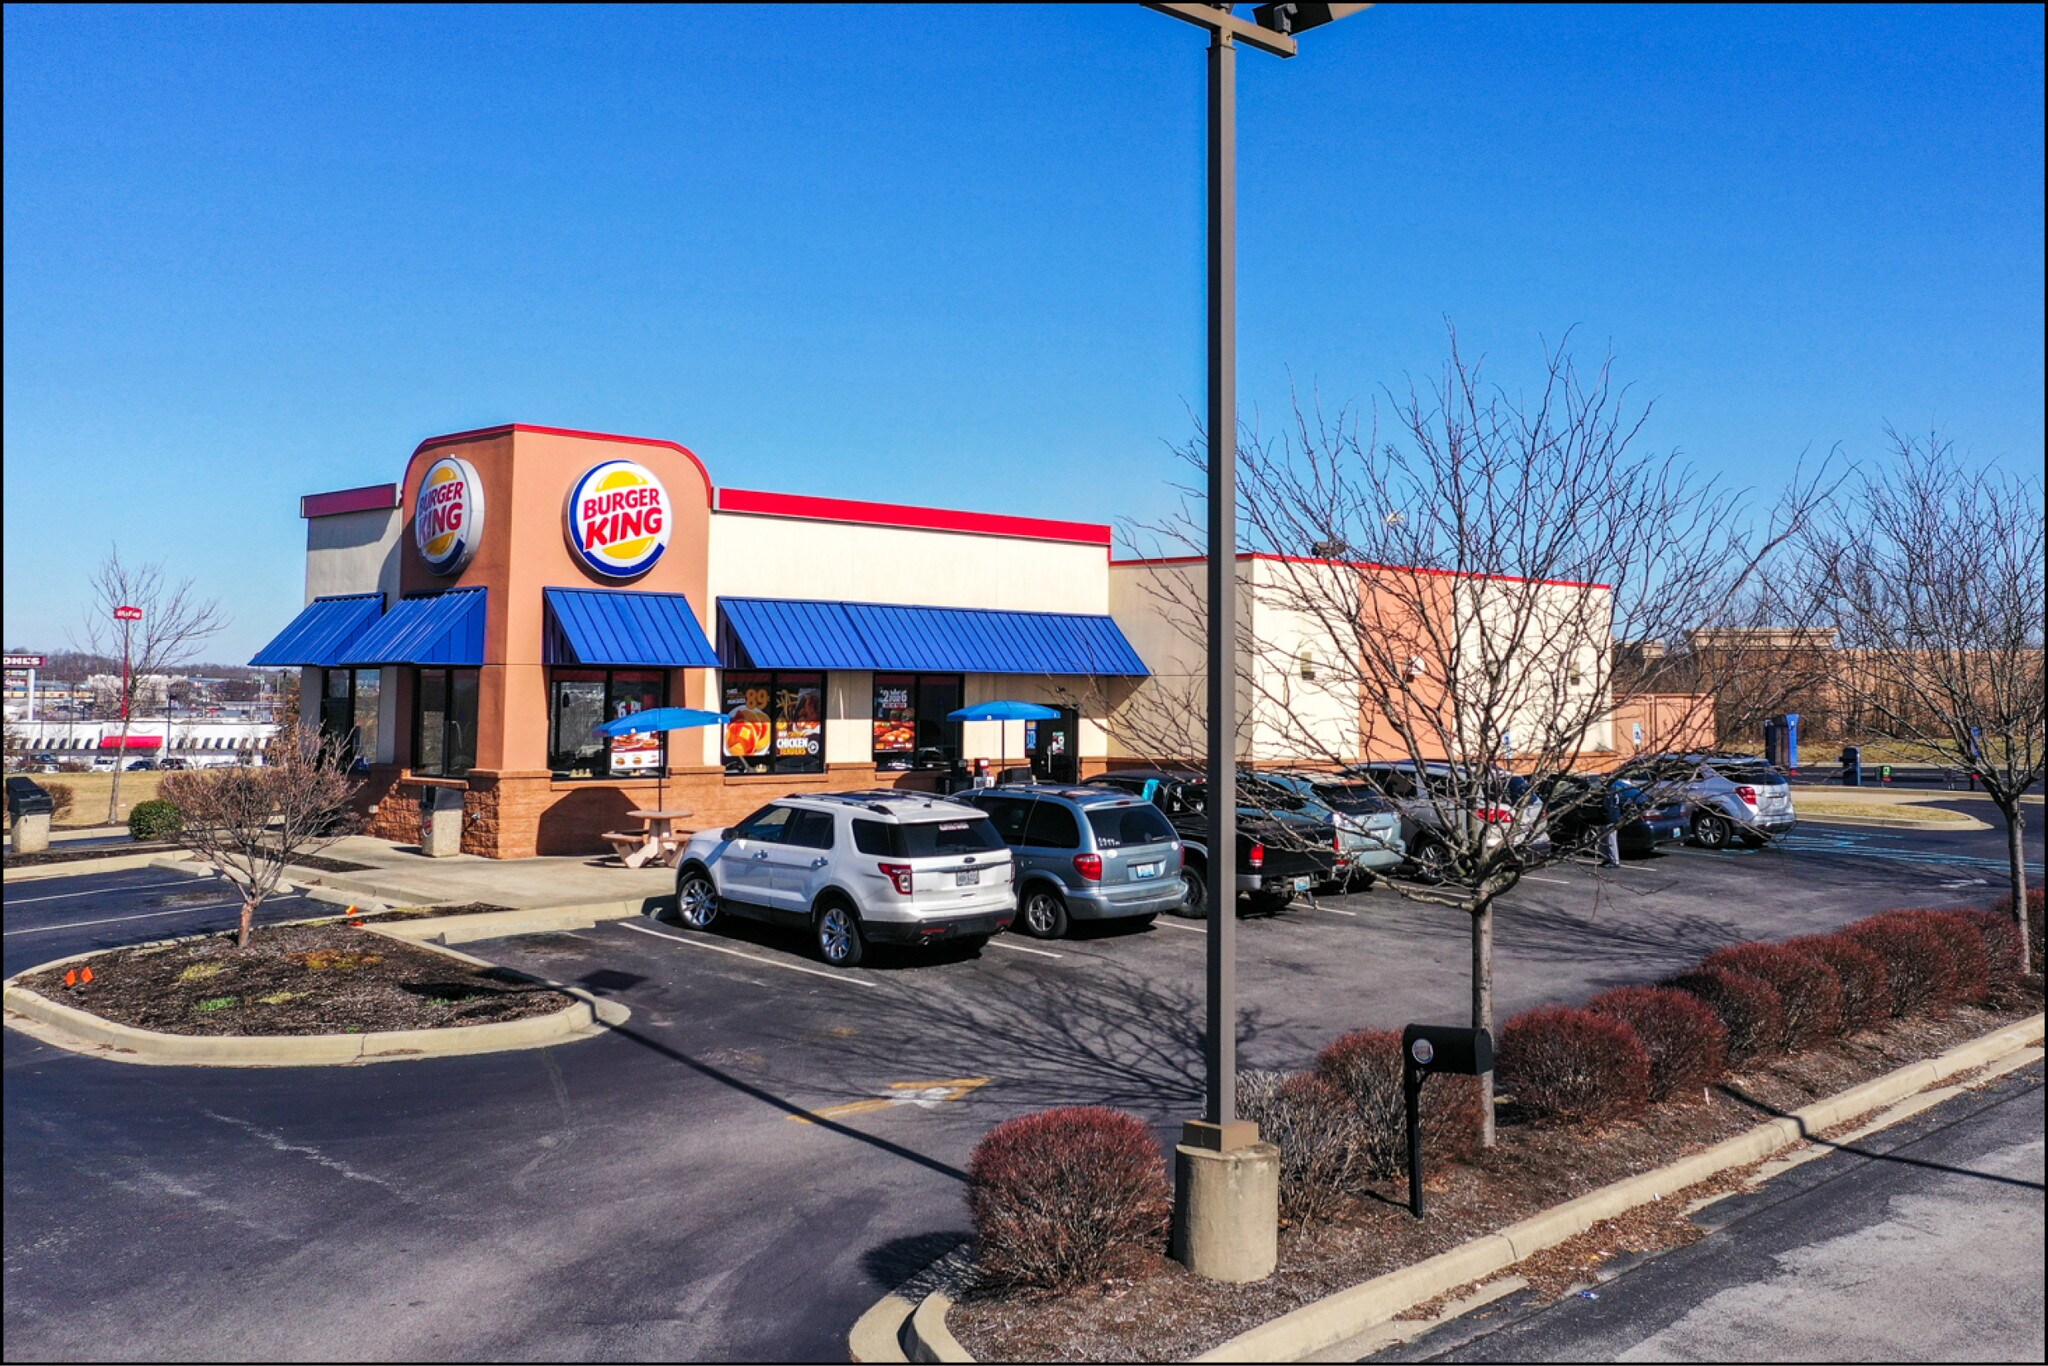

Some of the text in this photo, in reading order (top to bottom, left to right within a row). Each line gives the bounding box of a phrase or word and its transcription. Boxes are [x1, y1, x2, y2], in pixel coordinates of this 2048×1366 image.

[418, 481, 464, 518] BURGER
[583, 487, 660, 521] BURGER
[418, 502, 463, 546] KING
[585, 506, 663, 550] KING
[3, 657, 41, 665] OHL'S
[776, 737, 809, 749] CHICKEN
